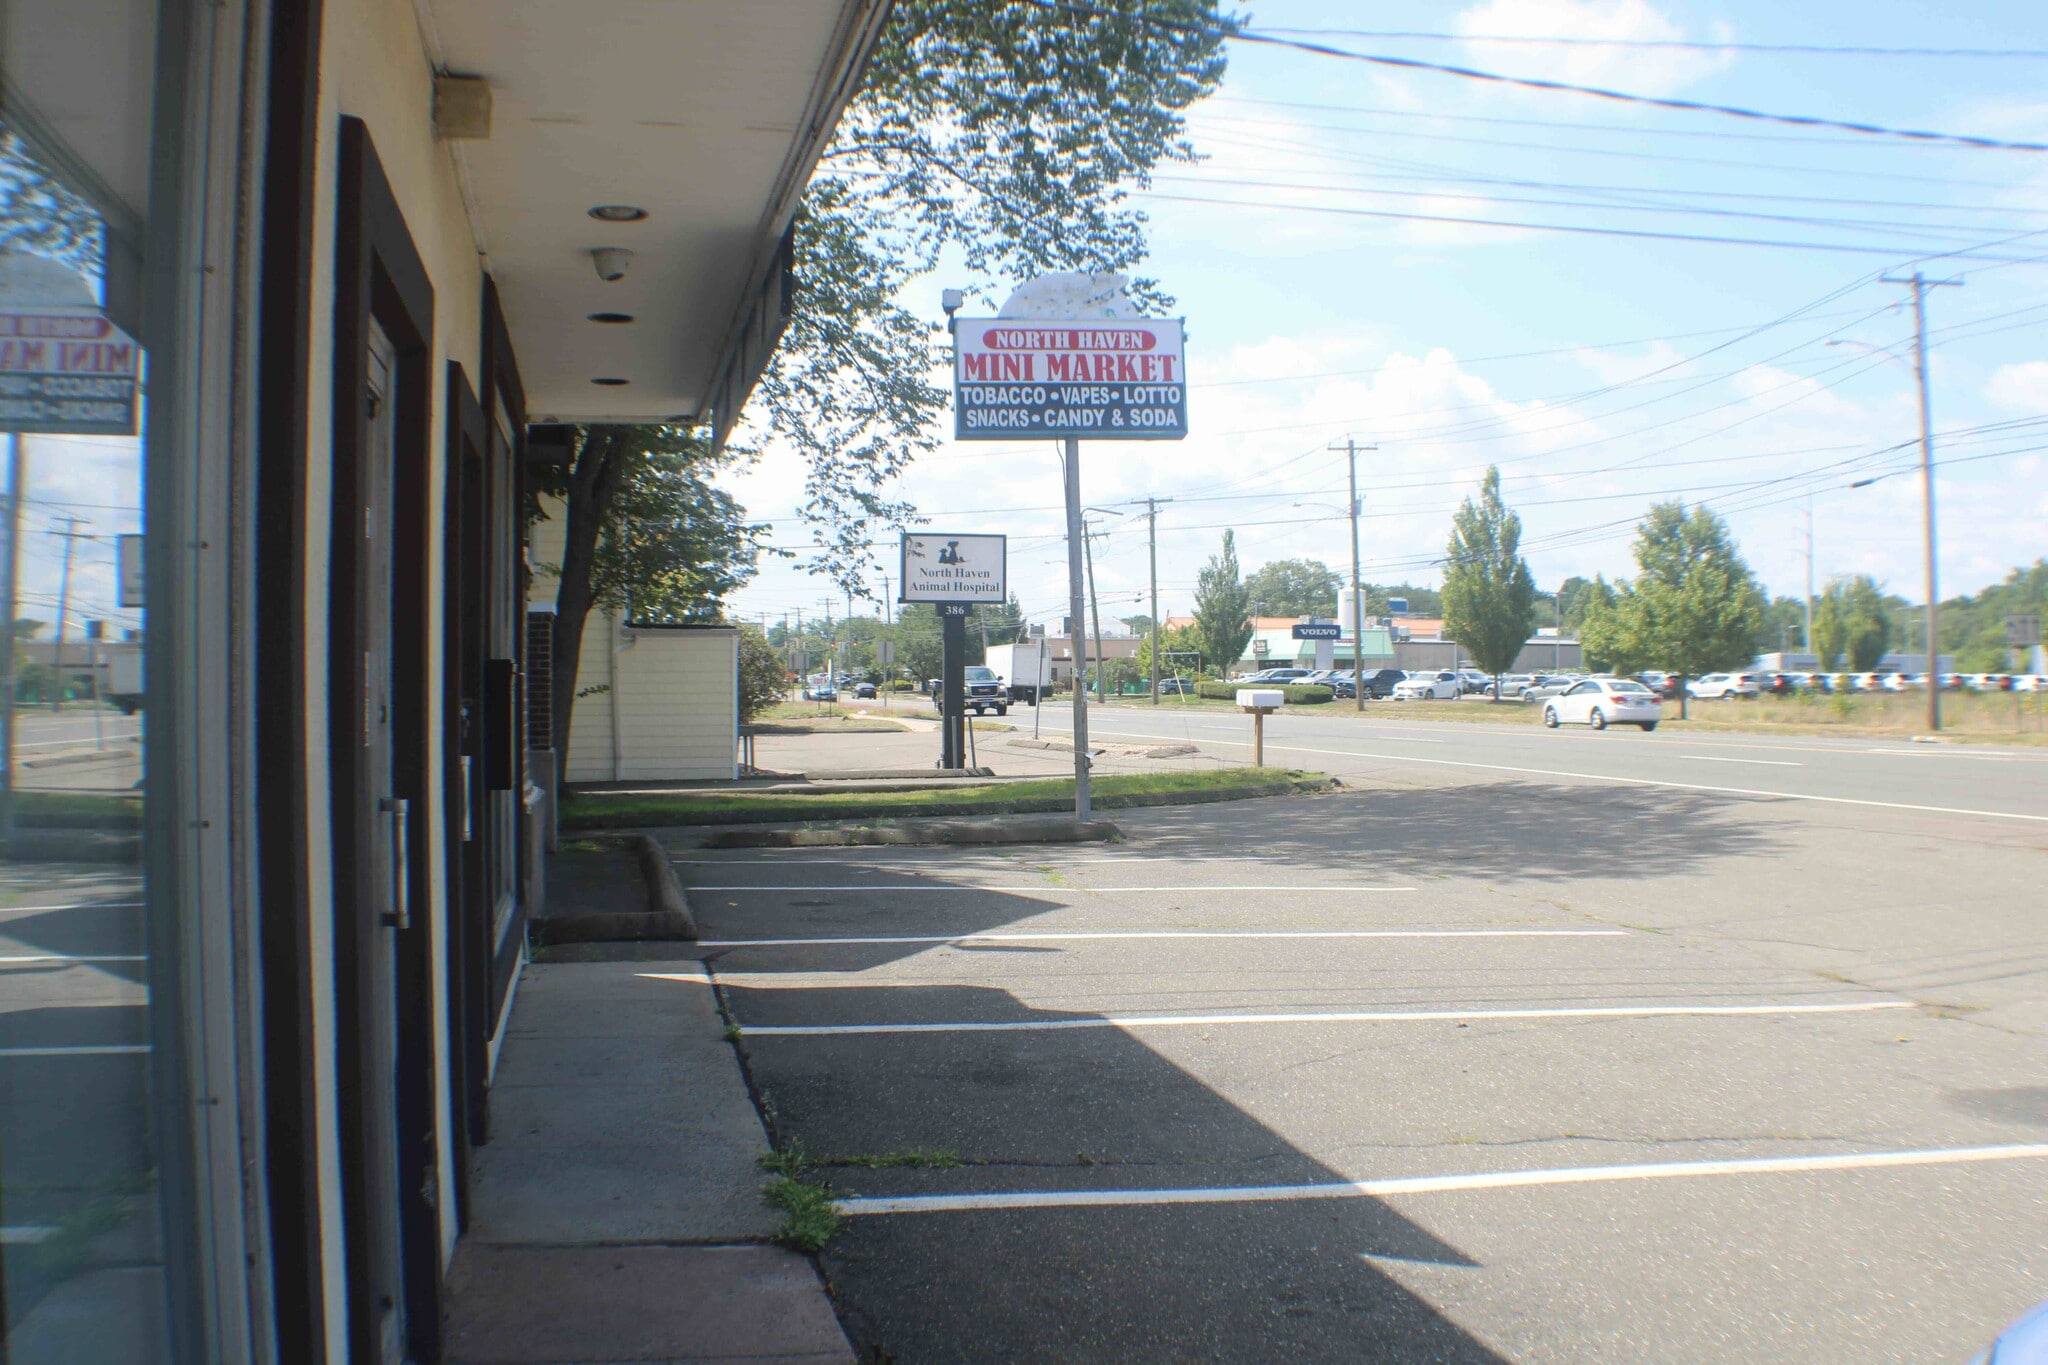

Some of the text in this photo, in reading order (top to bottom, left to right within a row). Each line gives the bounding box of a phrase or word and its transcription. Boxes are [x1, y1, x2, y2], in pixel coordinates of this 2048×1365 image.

[995, 330, 1144, 349] NORTH HAVEN
[963, 353, 1177, 382] MINI MARKET
[961, 386, 1180, 405] TOBACCO VAPES LOTTO
[966, 408, 1178, 428] SNACKS CANDY & SODA
[920, 567, 990, 578] North Haven
[910, 581, 999, 594] Animal Hospital
[946, 606, 964, 615] 386
